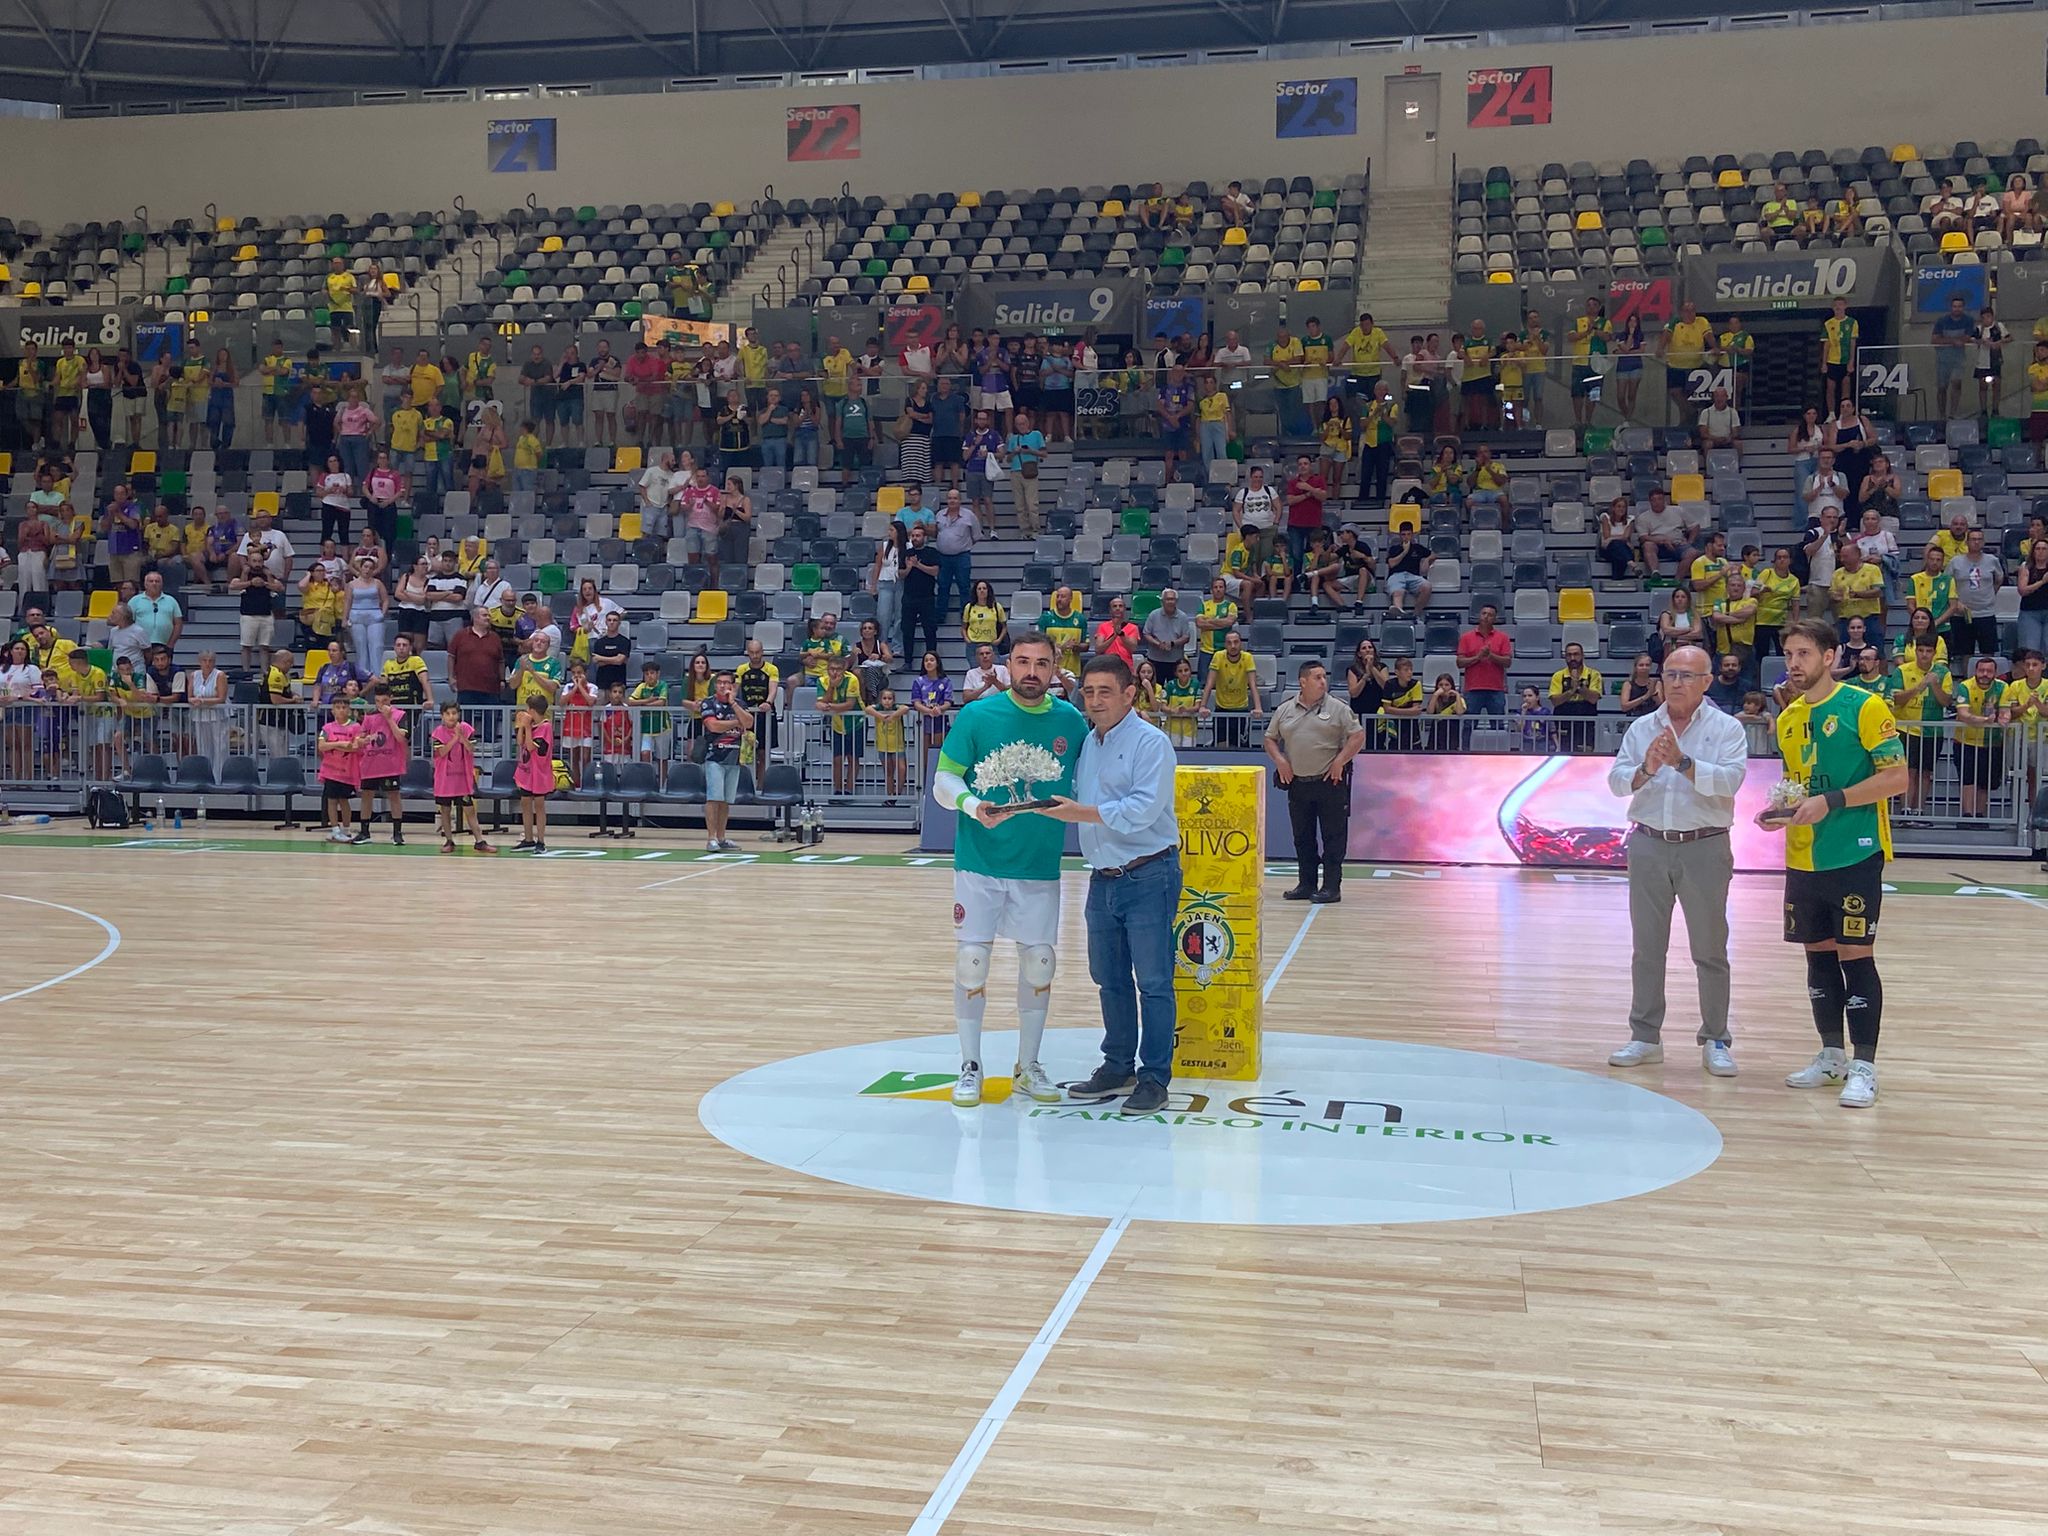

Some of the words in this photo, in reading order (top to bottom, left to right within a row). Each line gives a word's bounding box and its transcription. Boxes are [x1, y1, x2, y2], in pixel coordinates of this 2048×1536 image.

[1468, 70, 1522, 85] Sector
[1276, 82, 1328, 96] Sector
[1467, 66, 1552, 128] 24
[787, 108, 834, 122] Sector
[487, 121, 531, 134] Sector
[788, 105, 860, 160] 22
[489, 120, 556, 172] 21
[1716, 274, 1811, 299] Salida
[1813, 258, 1857, 296] 10
[1918, 269, 1960, 280] Sector
[1610, 280, 1650, 292] Sector
[995, 302, 1075, 325] Salida
[1089, 287, 1113, 322] 9
[1147, 300, 1182, 310] Sector
[1609, 279, 1674, 323] 24
[888, 307, 922, 317] Sector
[20, 326, 88, 346] Salida
[100, 313, 120, 344] 8
[136, 325, 166, 334] Sector
[1688, 369, 1732, 400] 24
[1862, 364, 1908, 396] 24
[1078, 388, 1120, 416] 23
[1077, 406, 1107, 415] Sector
[1803, 722, 1814, 738] 14
[1187, 913, 1221, 923] JAEN
[1847, 921, 1861, 930] LZ
[1281, 1120, 1559, 1146] INTERIOR
